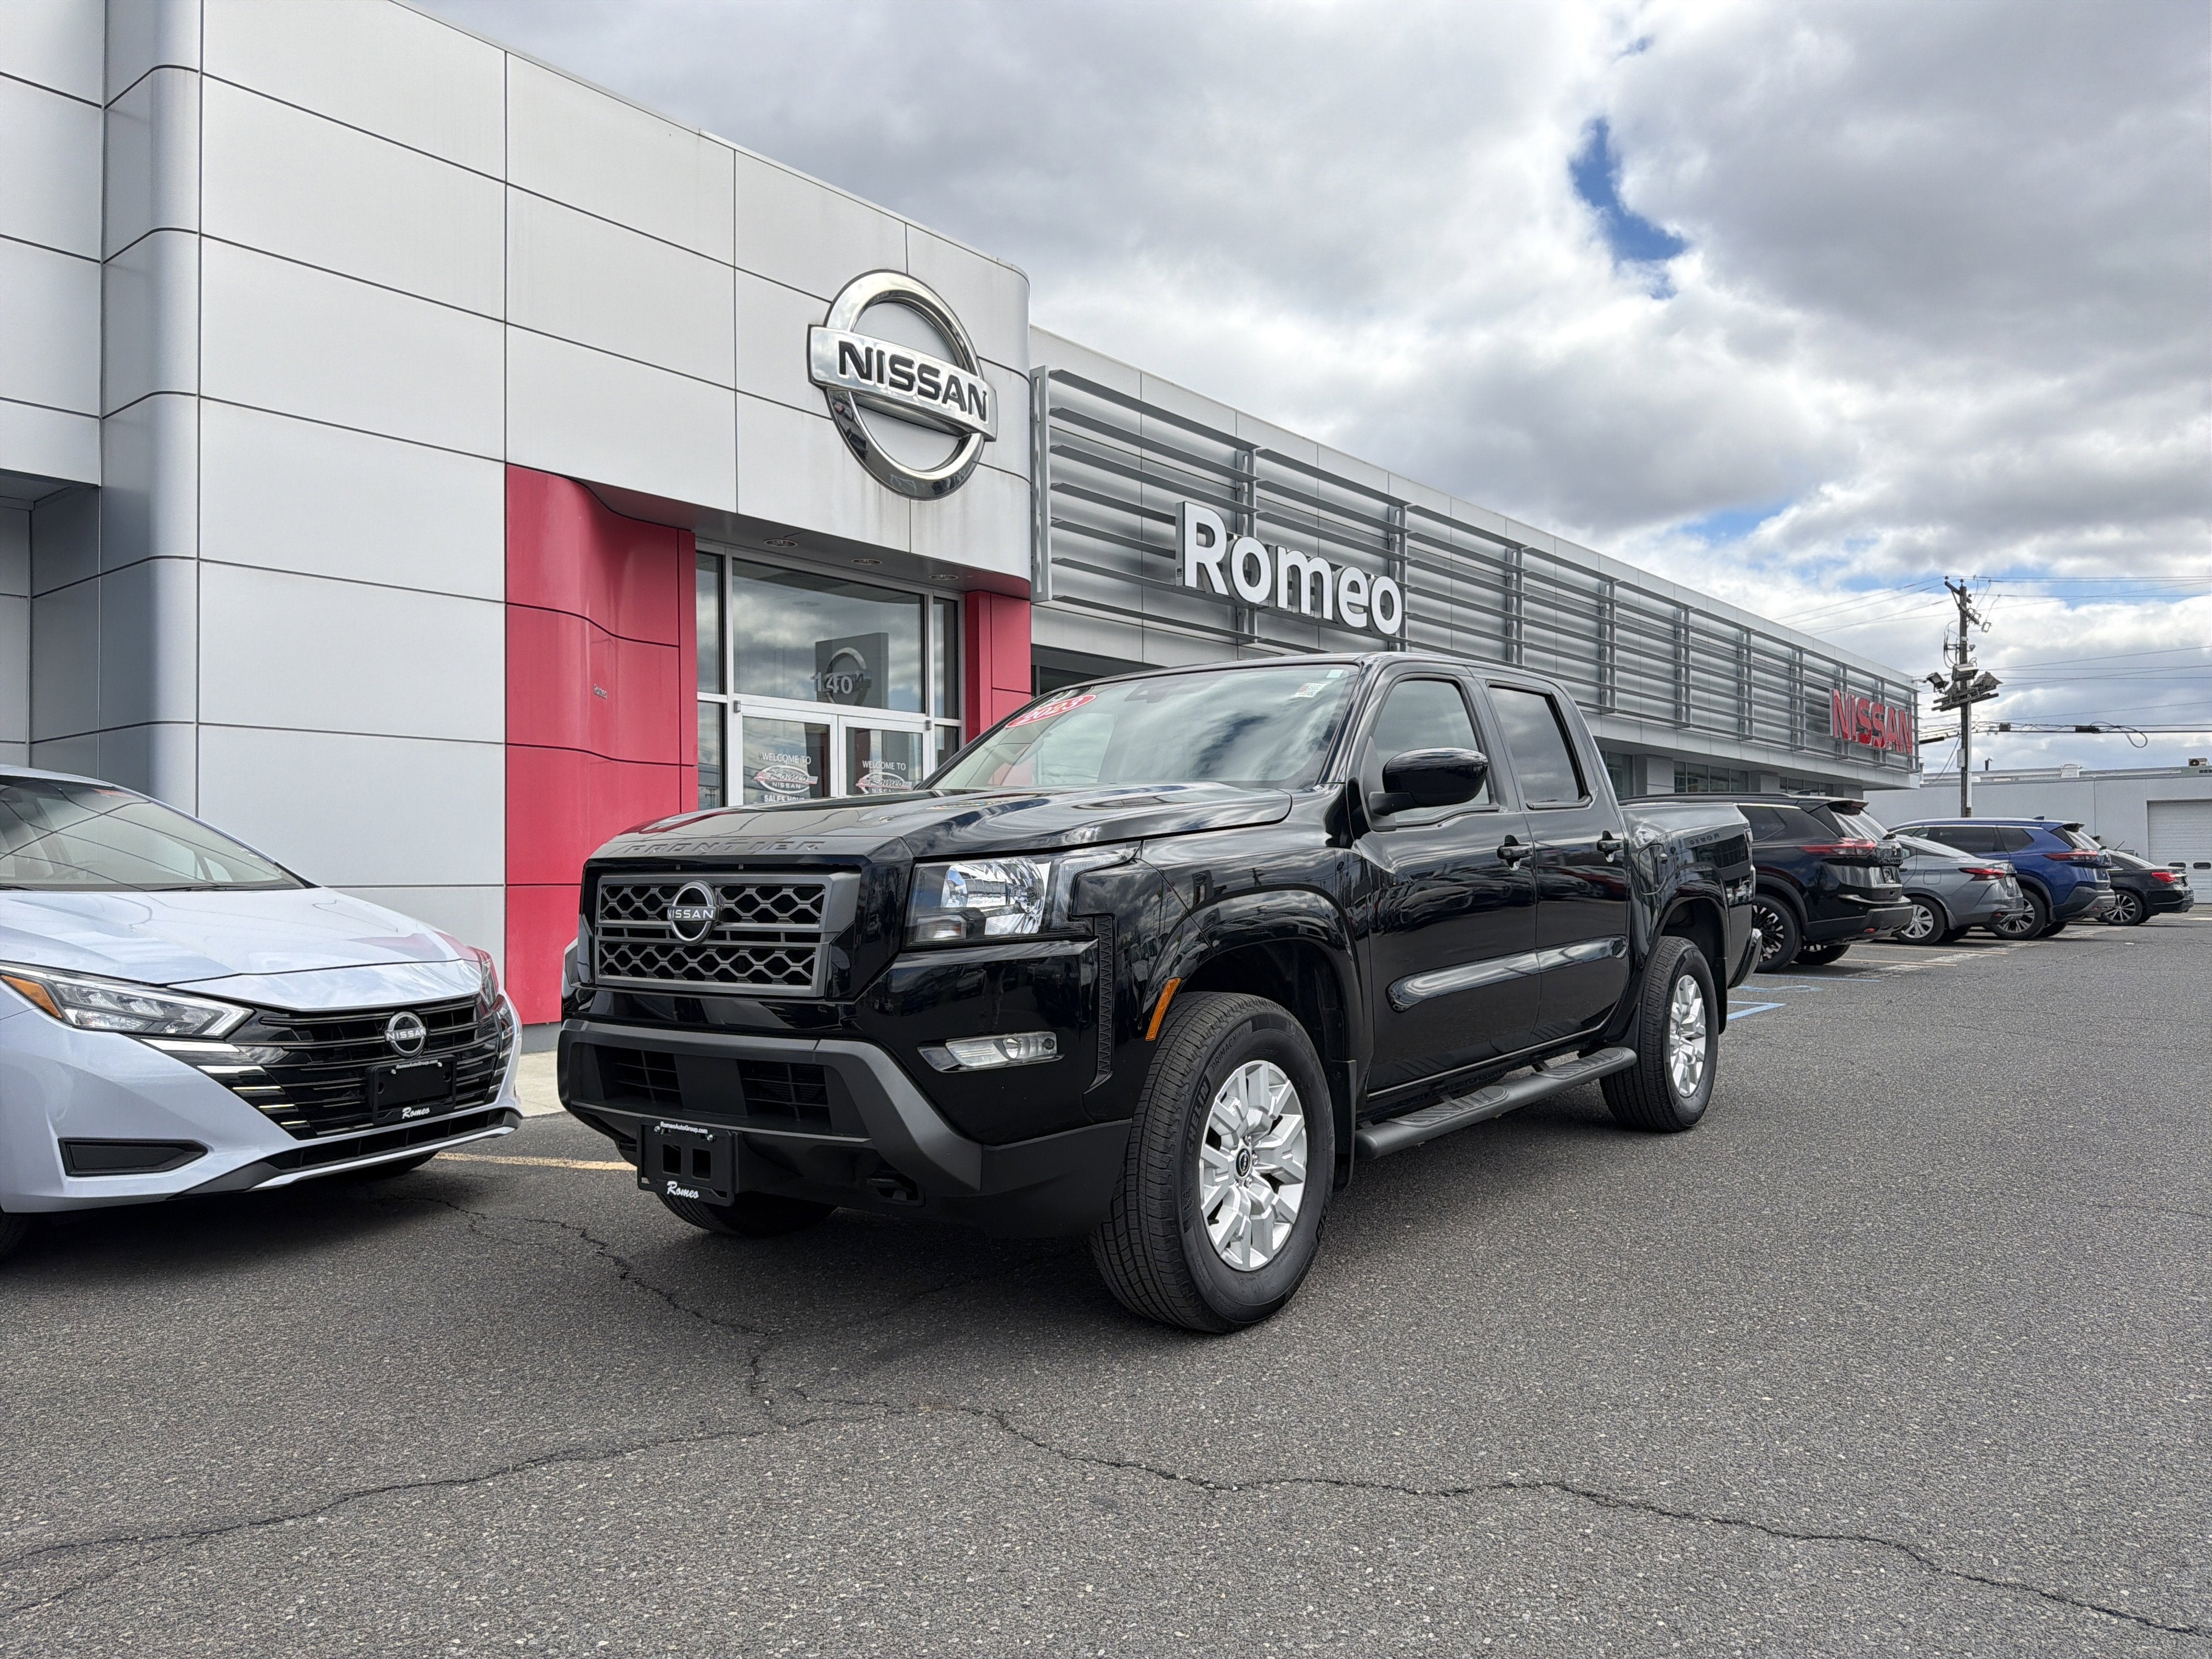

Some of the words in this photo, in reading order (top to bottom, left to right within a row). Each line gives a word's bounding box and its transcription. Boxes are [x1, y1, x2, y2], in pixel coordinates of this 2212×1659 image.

[838, 340, 987, 422] NISSAN
[1184, 500, 1403, 635] Romeo
[814, 672, 853, 694] 140
[1015, 697, 1084, 724] 2023
[1832, 689, 1913, 755] NISSAN
[761, 752, 798, 763] WELCOME
[800, 755, 811, 764] TO
[862, 760, 895, 770] WELCOME
[896, 763, 906, 771] TO
[766, 767, 808, 782] Romeo
[868, 773, 904, 787] Romeo
[764, 794, 785, 803] SALES
[622, 841, 826, 855] FRONTIER
[667, 909, 714, 919] NISSAN
[386, 1027, 426, 1042] NISSAN
[402, 1107, 430, 1120] Romeo
[660, 1121, 708, 1135] RomeoAutoGroup.com
[667, 1181, 699, 1199] Romeo
